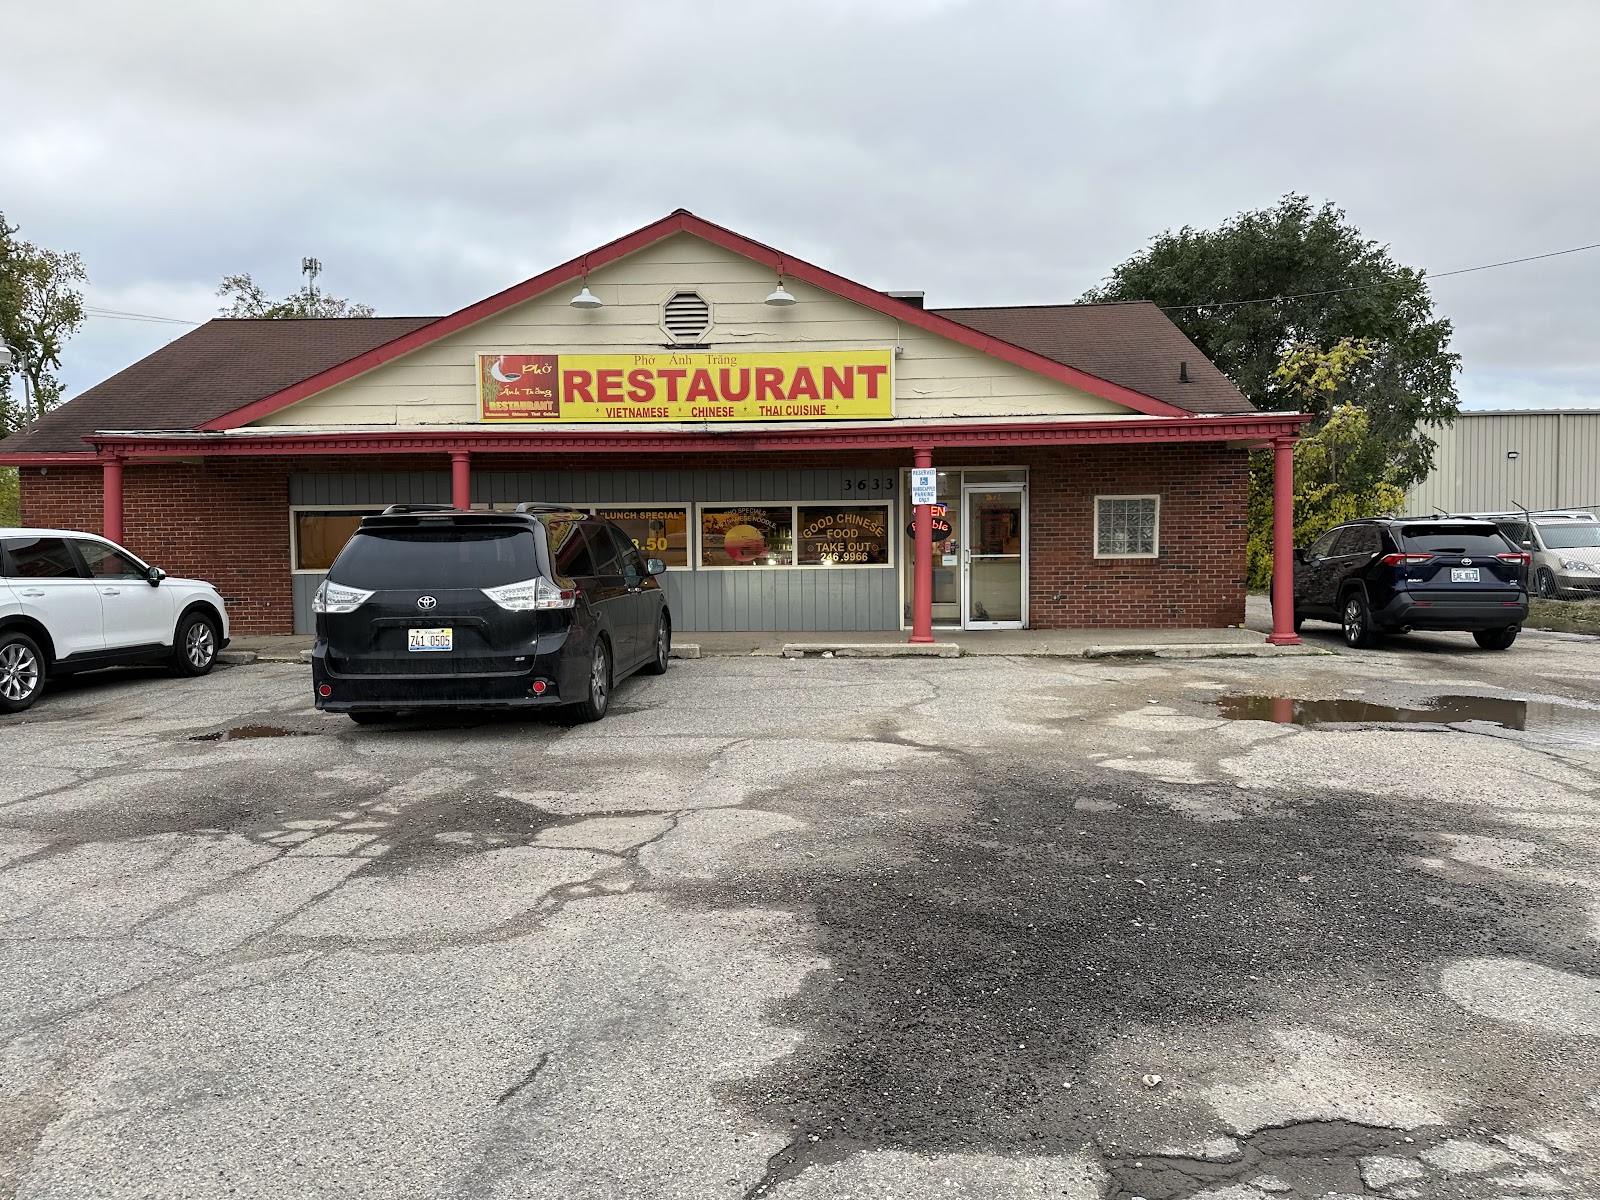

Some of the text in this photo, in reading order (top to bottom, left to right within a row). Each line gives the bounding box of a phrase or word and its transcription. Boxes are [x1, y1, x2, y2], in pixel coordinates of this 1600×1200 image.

[669, 352, 692, 365] Ánh
[705, 354, 737, 367] Trăng
[563, 365, 888, 403] RESTAURANT
[489, 401, 554, 410] RESTAURANT
[606, 405, 826, 418] VIETNAMESE CHINESE THAI CUISINE
[843, 478, 893, 490] 3633
[752, 516, 778, 529] NOODLE
[803, 513, 885, 538] GOOD CHINESE
[827, 528, 859, 539] FOOD
[815, 542, 872, 552] TAKE OUT
[410, 635, 451, 647] Z41 0505
